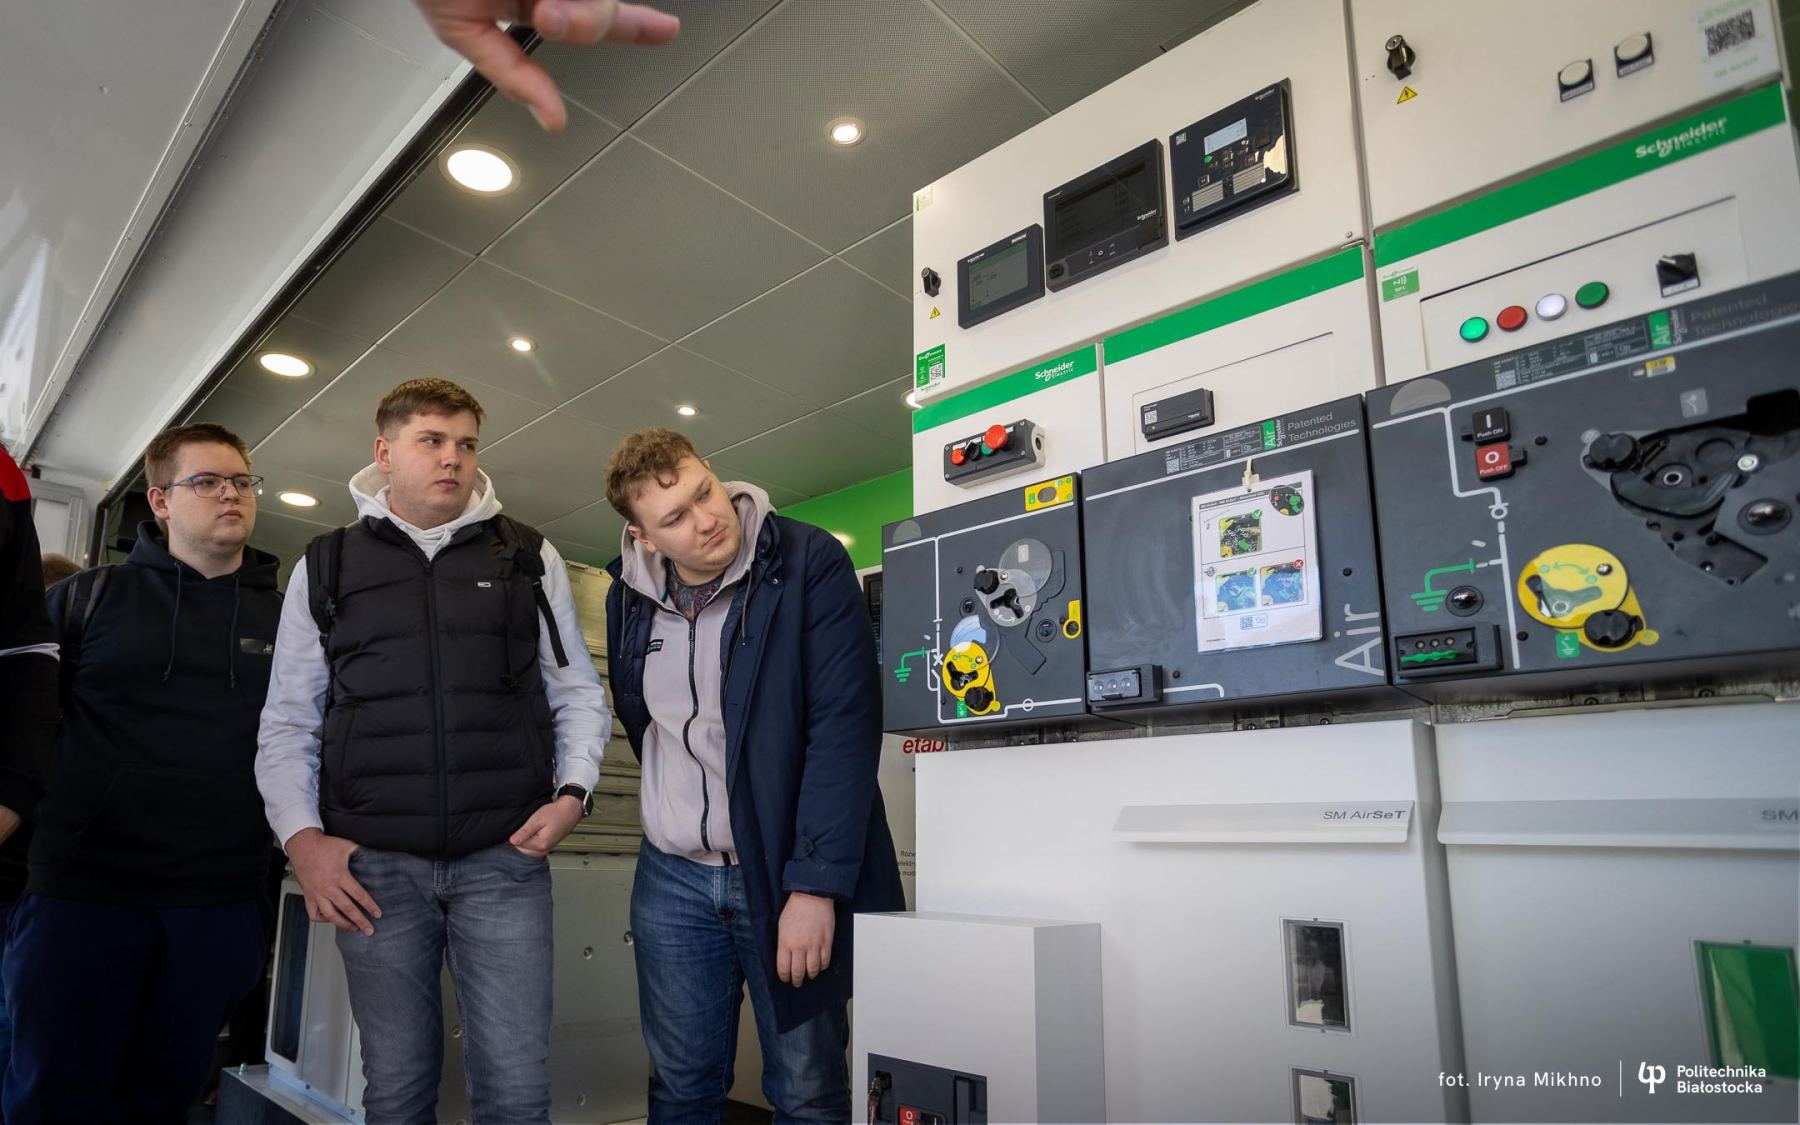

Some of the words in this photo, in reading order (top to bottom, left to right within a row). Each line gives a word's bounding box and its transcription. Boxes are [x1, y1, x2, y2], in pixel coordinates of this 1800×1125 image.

[1635, 116, 1727, 158] Schneider
[1034, 361, 1075, 382] Schneider
[1287, 411, 1334, 431] Patented
[1263, 430, 1277, 448] Air
[1289, 420, 1357, 442] Technologies
[1477, 430, 1492, 438] Push
[1492, 427, 1503, 435] ON
[1479, 466, 1495, 475] Push
[1495, 464, 1508, 473] OFF
[1333, 603, 1385, 677] Air
[1323, 811, 1347, 820] SM
[1350, 810, 1406, 820] AirSeT
[1761, 809, 1799, 821] SM
